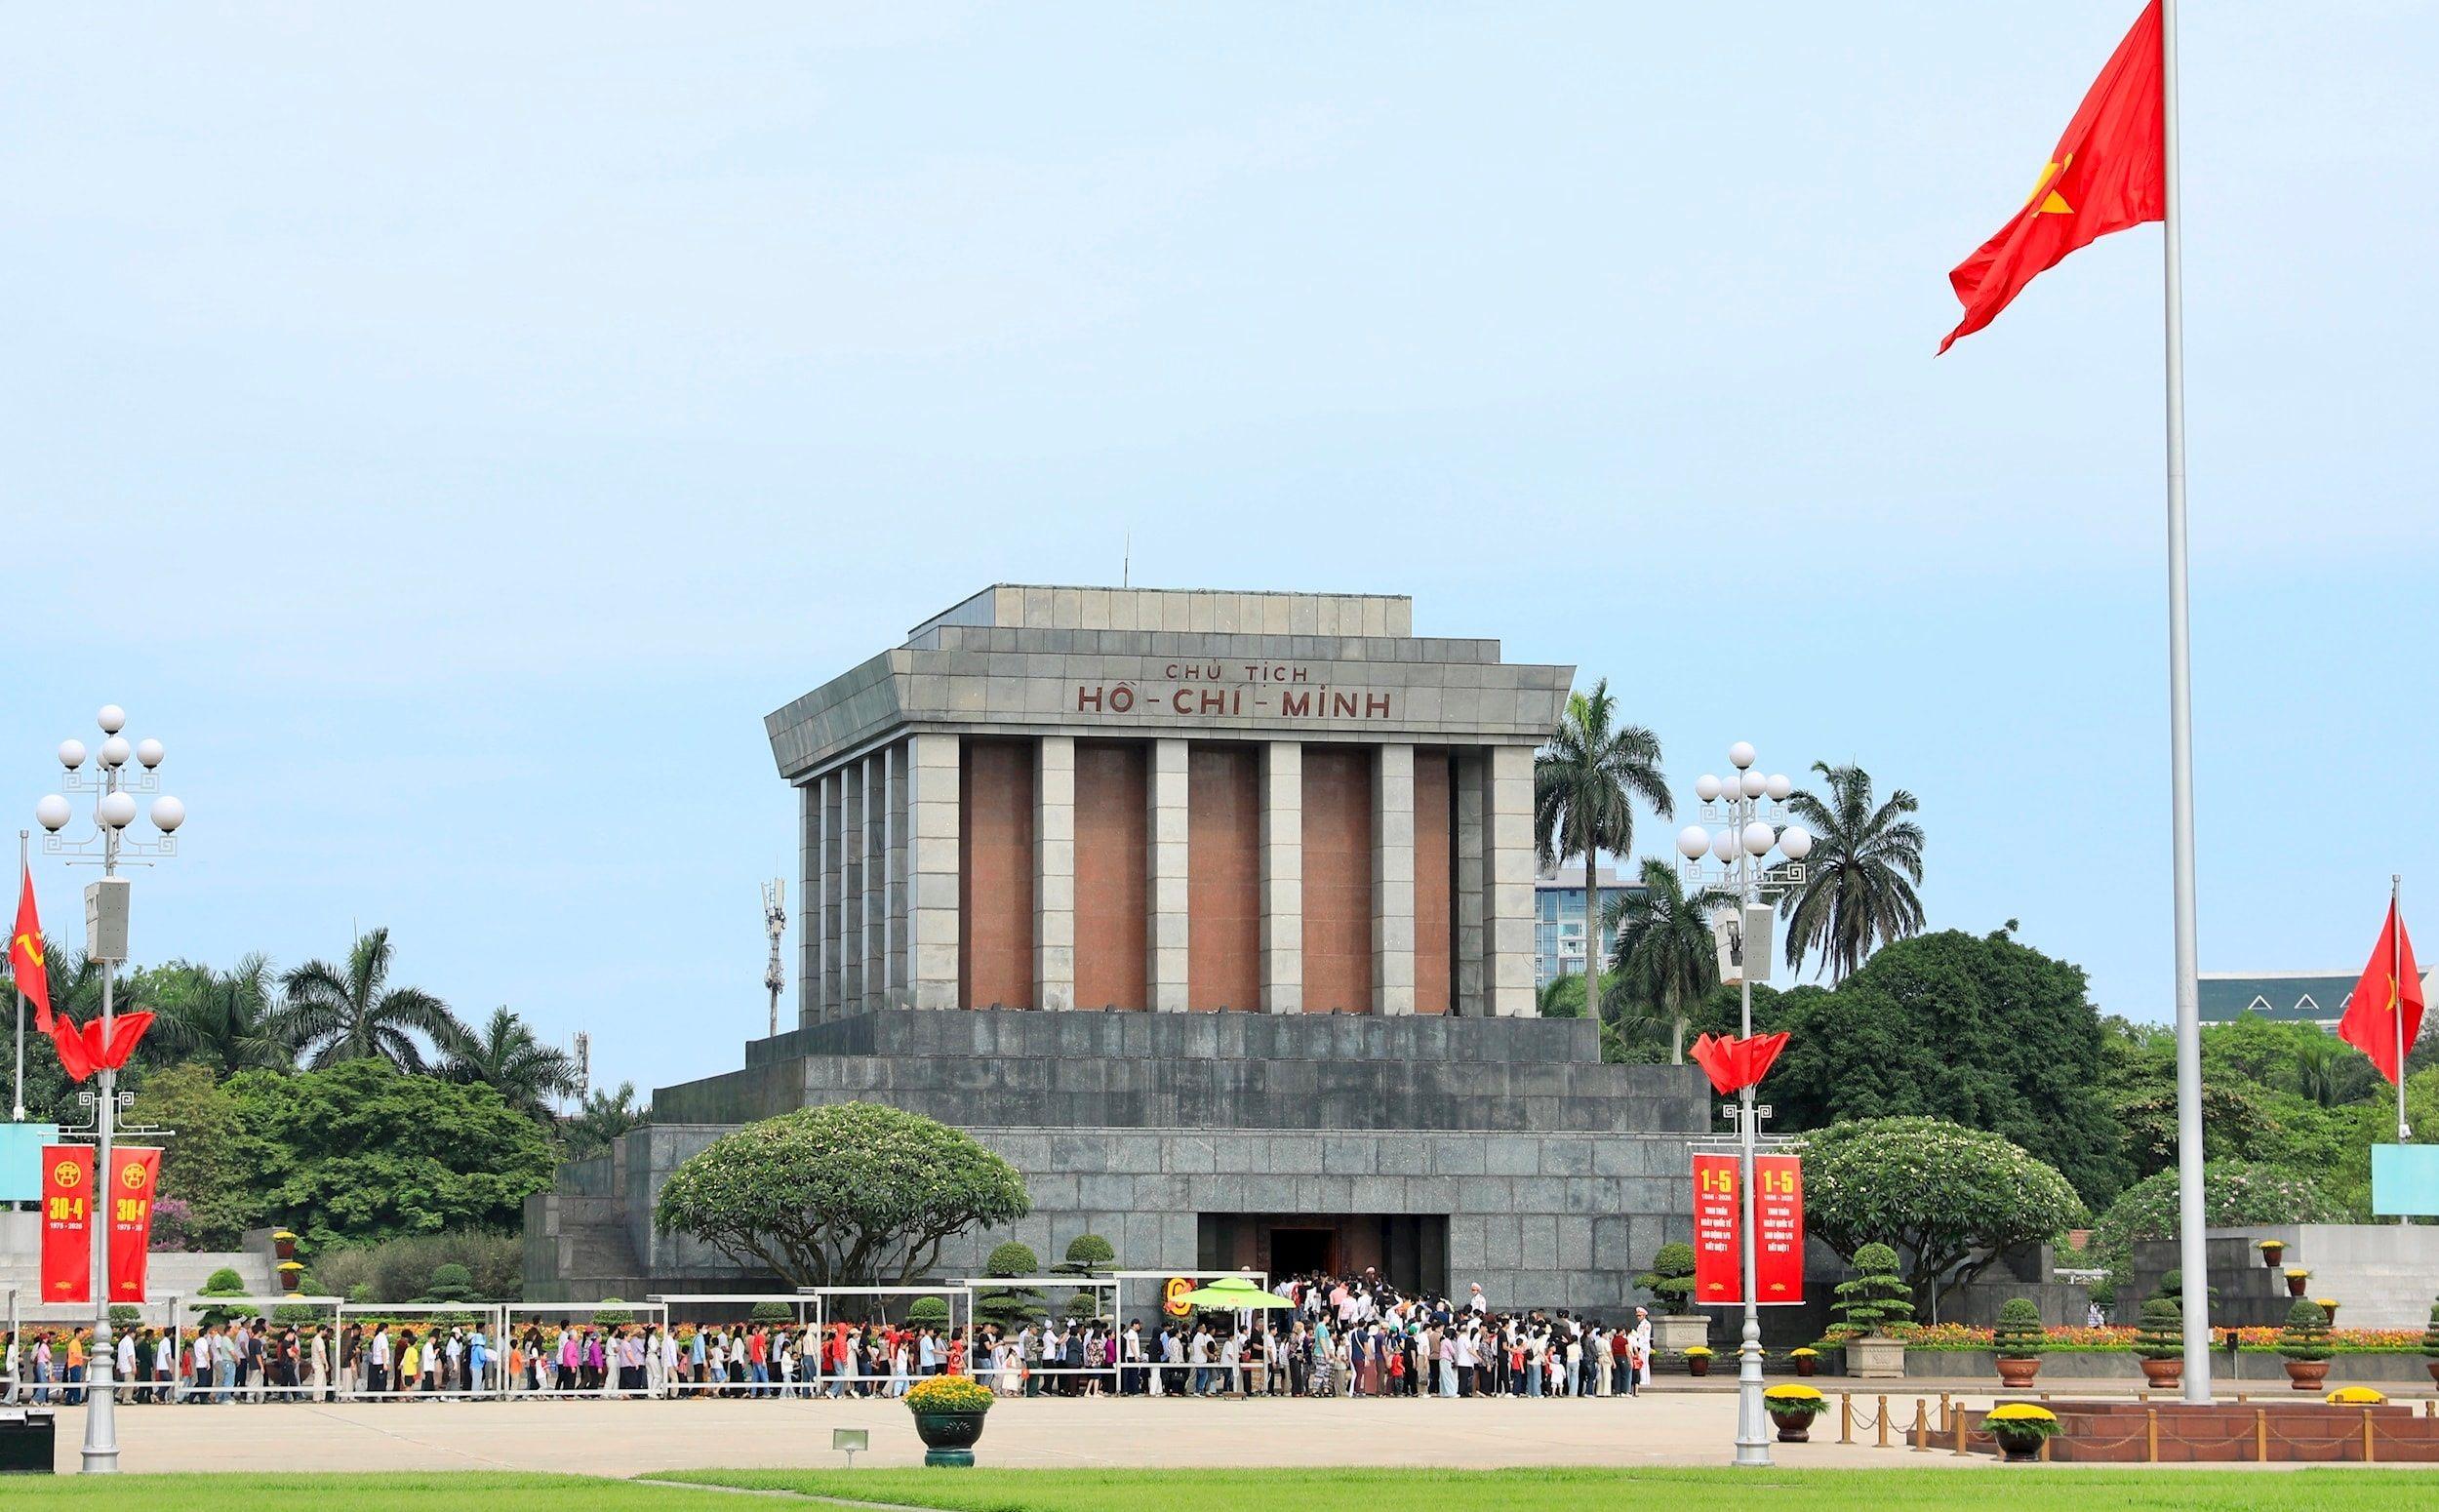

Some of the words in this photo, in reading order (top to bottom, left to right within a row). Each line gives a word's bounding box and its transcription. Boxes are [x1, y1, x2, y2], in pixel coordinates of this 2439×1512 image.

[1165, 658, 1221, 681] CHỦ
[1078, 682, 1137, 713] HỒ
[1172, 683, 1253, 715] CHÍ
[1282, 684, 1390, 719] MINH
[1700, 1169, 1732, 1193] 1-5
[1762, 1170, 1794, 1193] 1-5
[50, 1197, 83, 1220] 30-4
